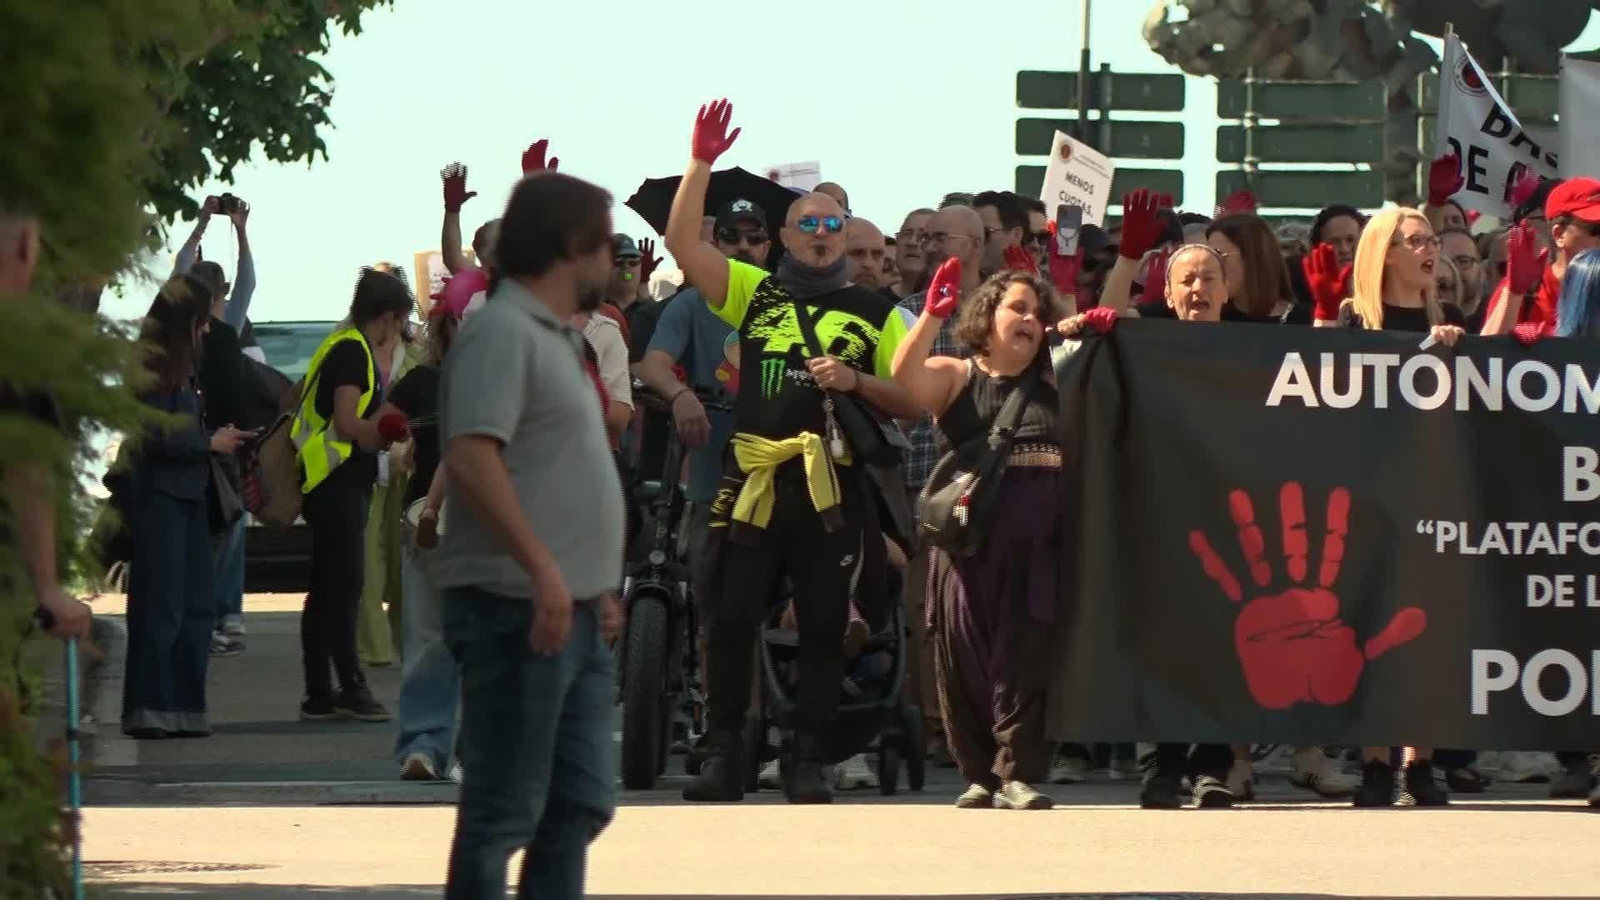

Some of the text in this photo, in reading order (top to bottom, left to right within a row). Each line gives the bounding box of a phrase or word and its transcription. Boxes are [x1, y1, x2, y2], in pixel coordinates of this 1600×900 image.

[1065, 171, 1094, 195] MENOS
[1527, 575, 1575, 607] DE
[1472, 649, 1600, 717] PO
